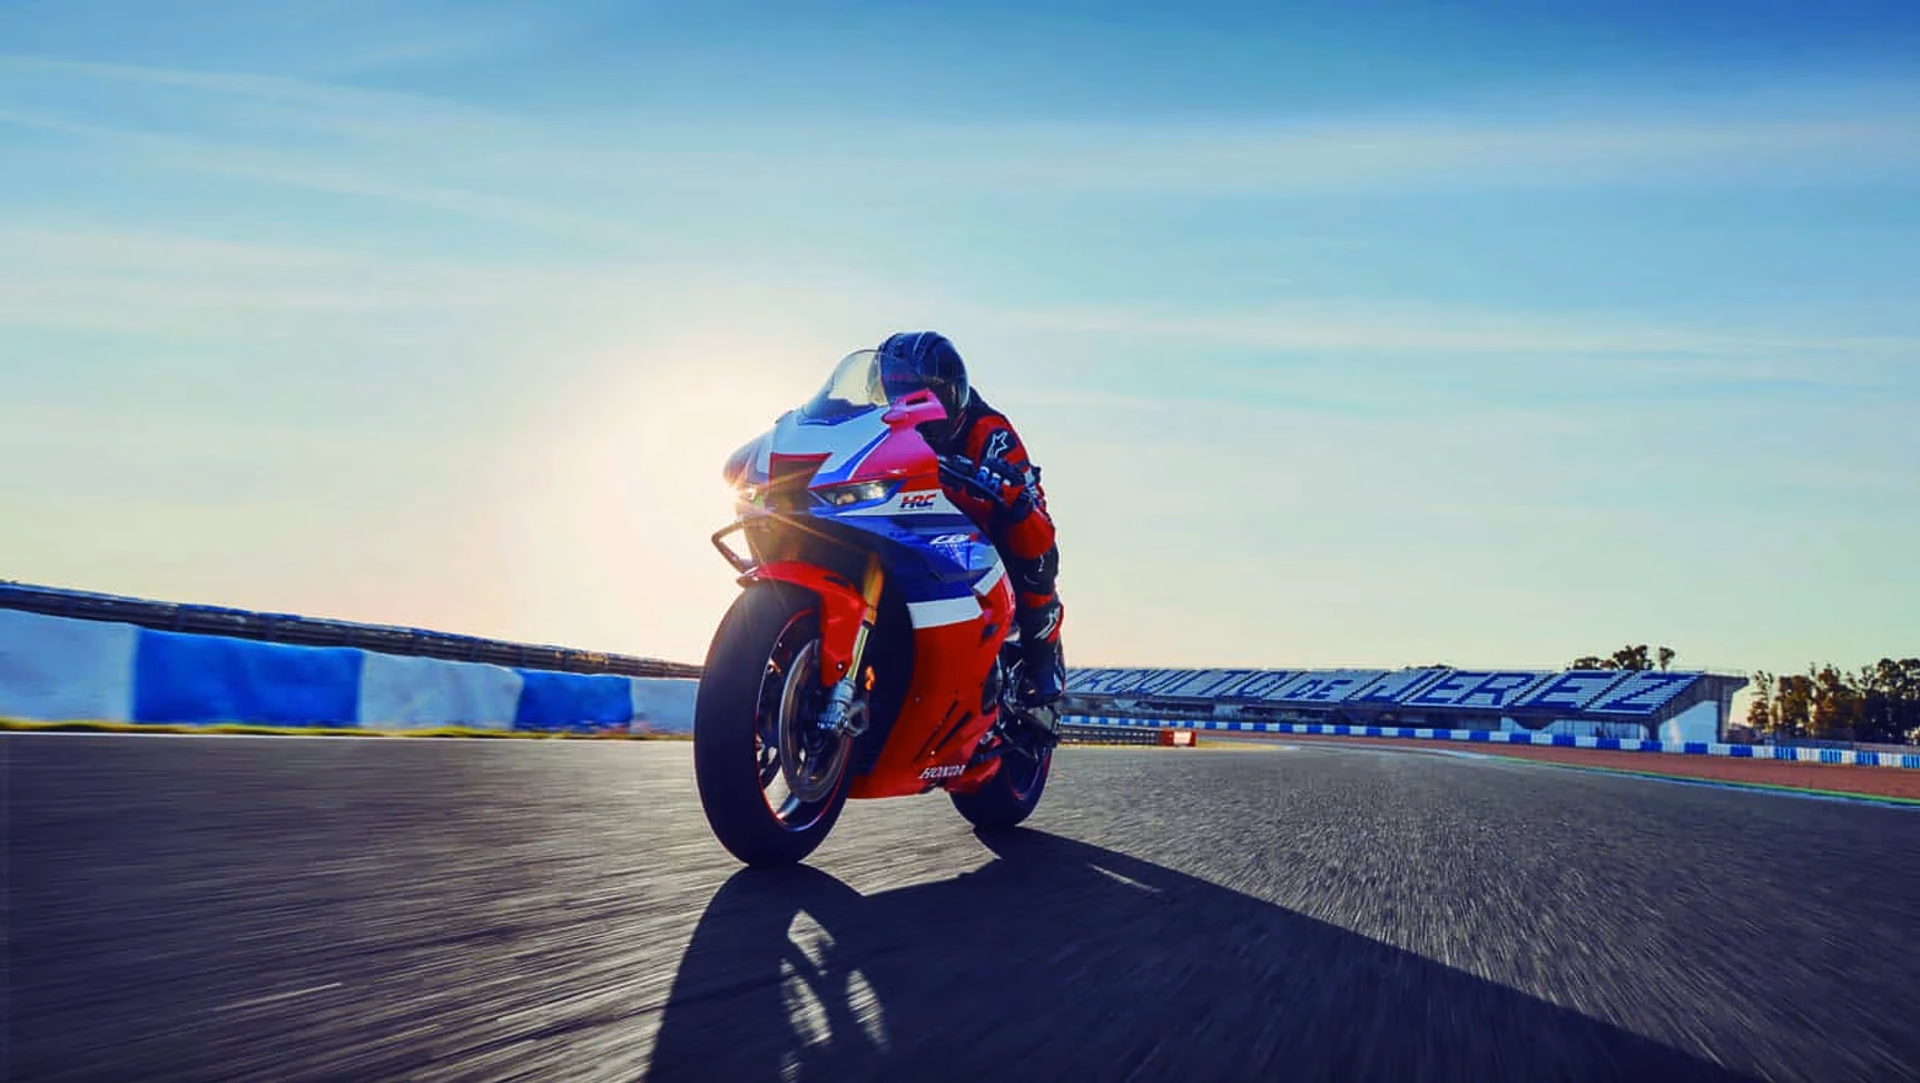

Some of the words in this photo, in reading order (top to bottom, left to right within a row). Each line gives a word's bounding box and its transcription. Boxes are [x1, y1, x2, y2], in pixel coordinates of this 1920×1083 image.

[900, 494, 937, 508] HRC
[1284, 679, 1353, 699] DE
[1358, 669, 1699, 710] JEREZ
[918, 765, 966, 779] HONDA
